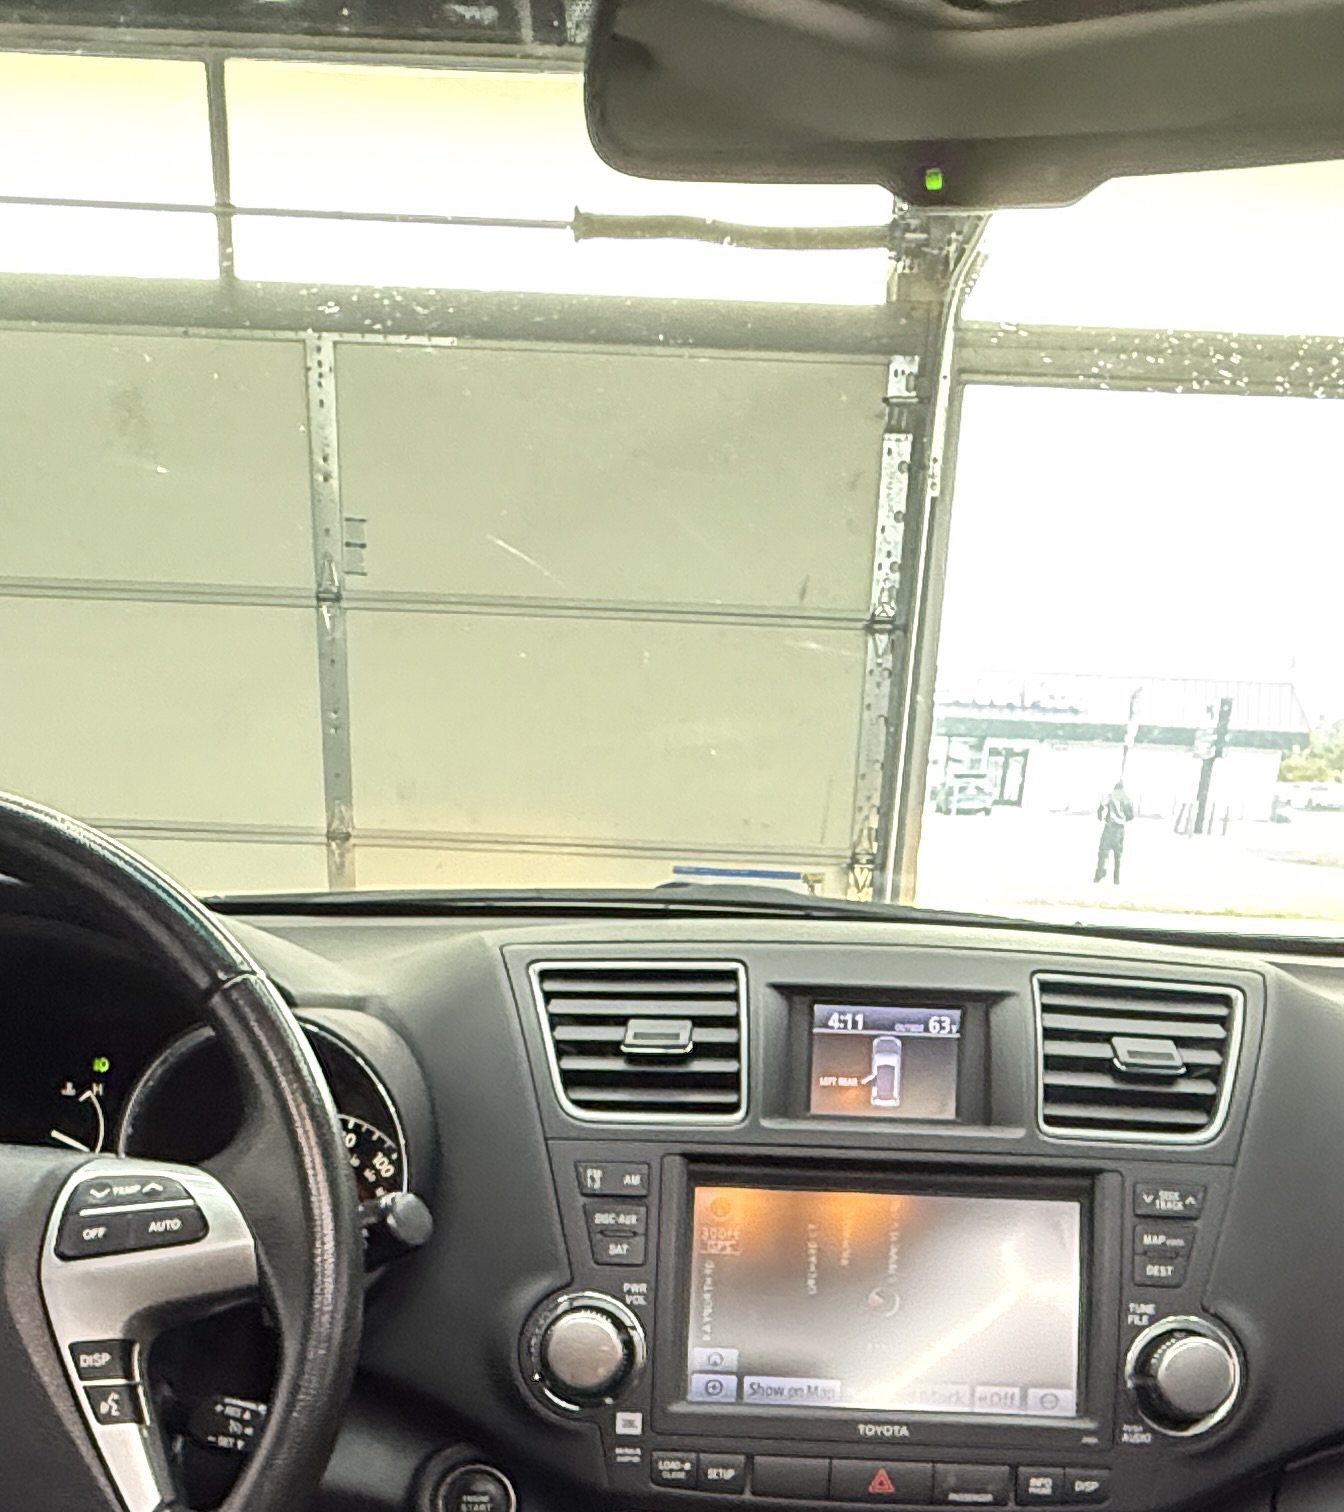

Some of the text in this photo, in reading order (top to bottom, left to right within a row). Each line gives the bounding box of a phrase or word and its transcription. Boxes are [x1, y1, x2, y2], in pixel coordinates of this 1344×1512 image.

[827, 1012, 864, 1031] 4:11
[371, 1151, 395, 1179] 100
[623, 1173, 642, 1186] AM
[148, 1217, 182, 1233] AUTO
[82, 1227, 106, 1241] OFF
[1143, 1233, 1167, 1247] MAP
[608, 1242, 630, 1255] SAT
[1145, 1263, 1175, 1277] DEST
[623, 1282, 648, 1293] PWR
[625, 1294, 648, 1306] VOL
[1128, 1302, 1156, 1316] TUNE
[1127, 1314, 1150, 1327] FILE
[79, 1352, 112, 1368] DISP
[748, 1381, 785, 1397] Show
[857, 1423, 910, 1438] TOYOTA
[1121, 1432, 1153, 1445] AUDIO
[460, 1503, 494, 1512] START
